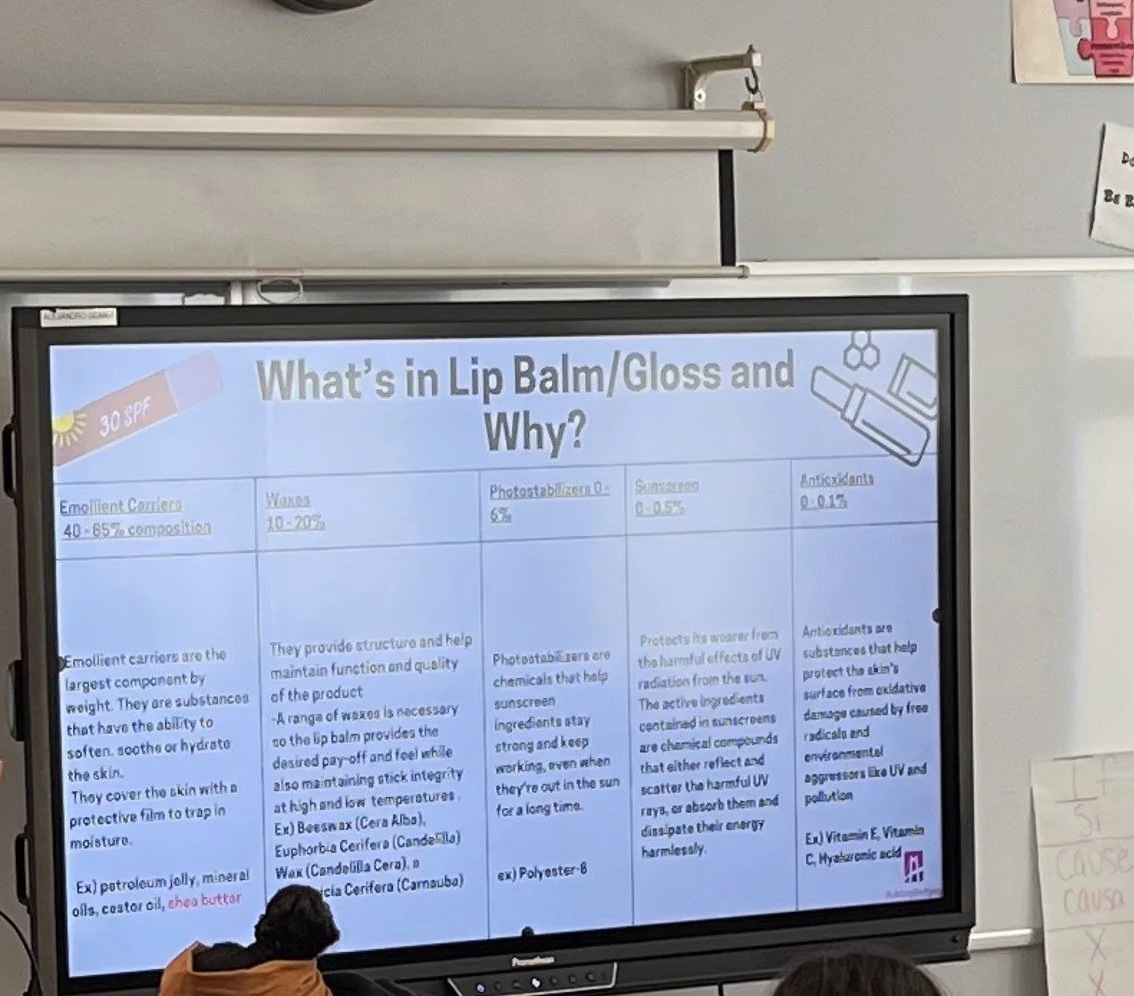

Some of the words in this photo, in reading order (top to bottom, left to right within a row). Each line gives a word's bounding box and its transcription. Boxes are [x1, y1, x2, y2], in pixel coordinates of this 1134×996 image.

[256, 358, 396, 401] What's
[406, 357, 439, 398] in
[449, 356, 503, 405] Lip
[514, 350, 722, 398] Balm/Gloss
[731, 348, 794, 388] and
[99, 410, 121, 438] 30
[125, 396, 152, 428] SPF
[484, 408, 587, 459] Why?
[59, 498, 123, 516] Emollient
[63, 523, 81, 539] 40
[128, 520, 212, 538] composition
